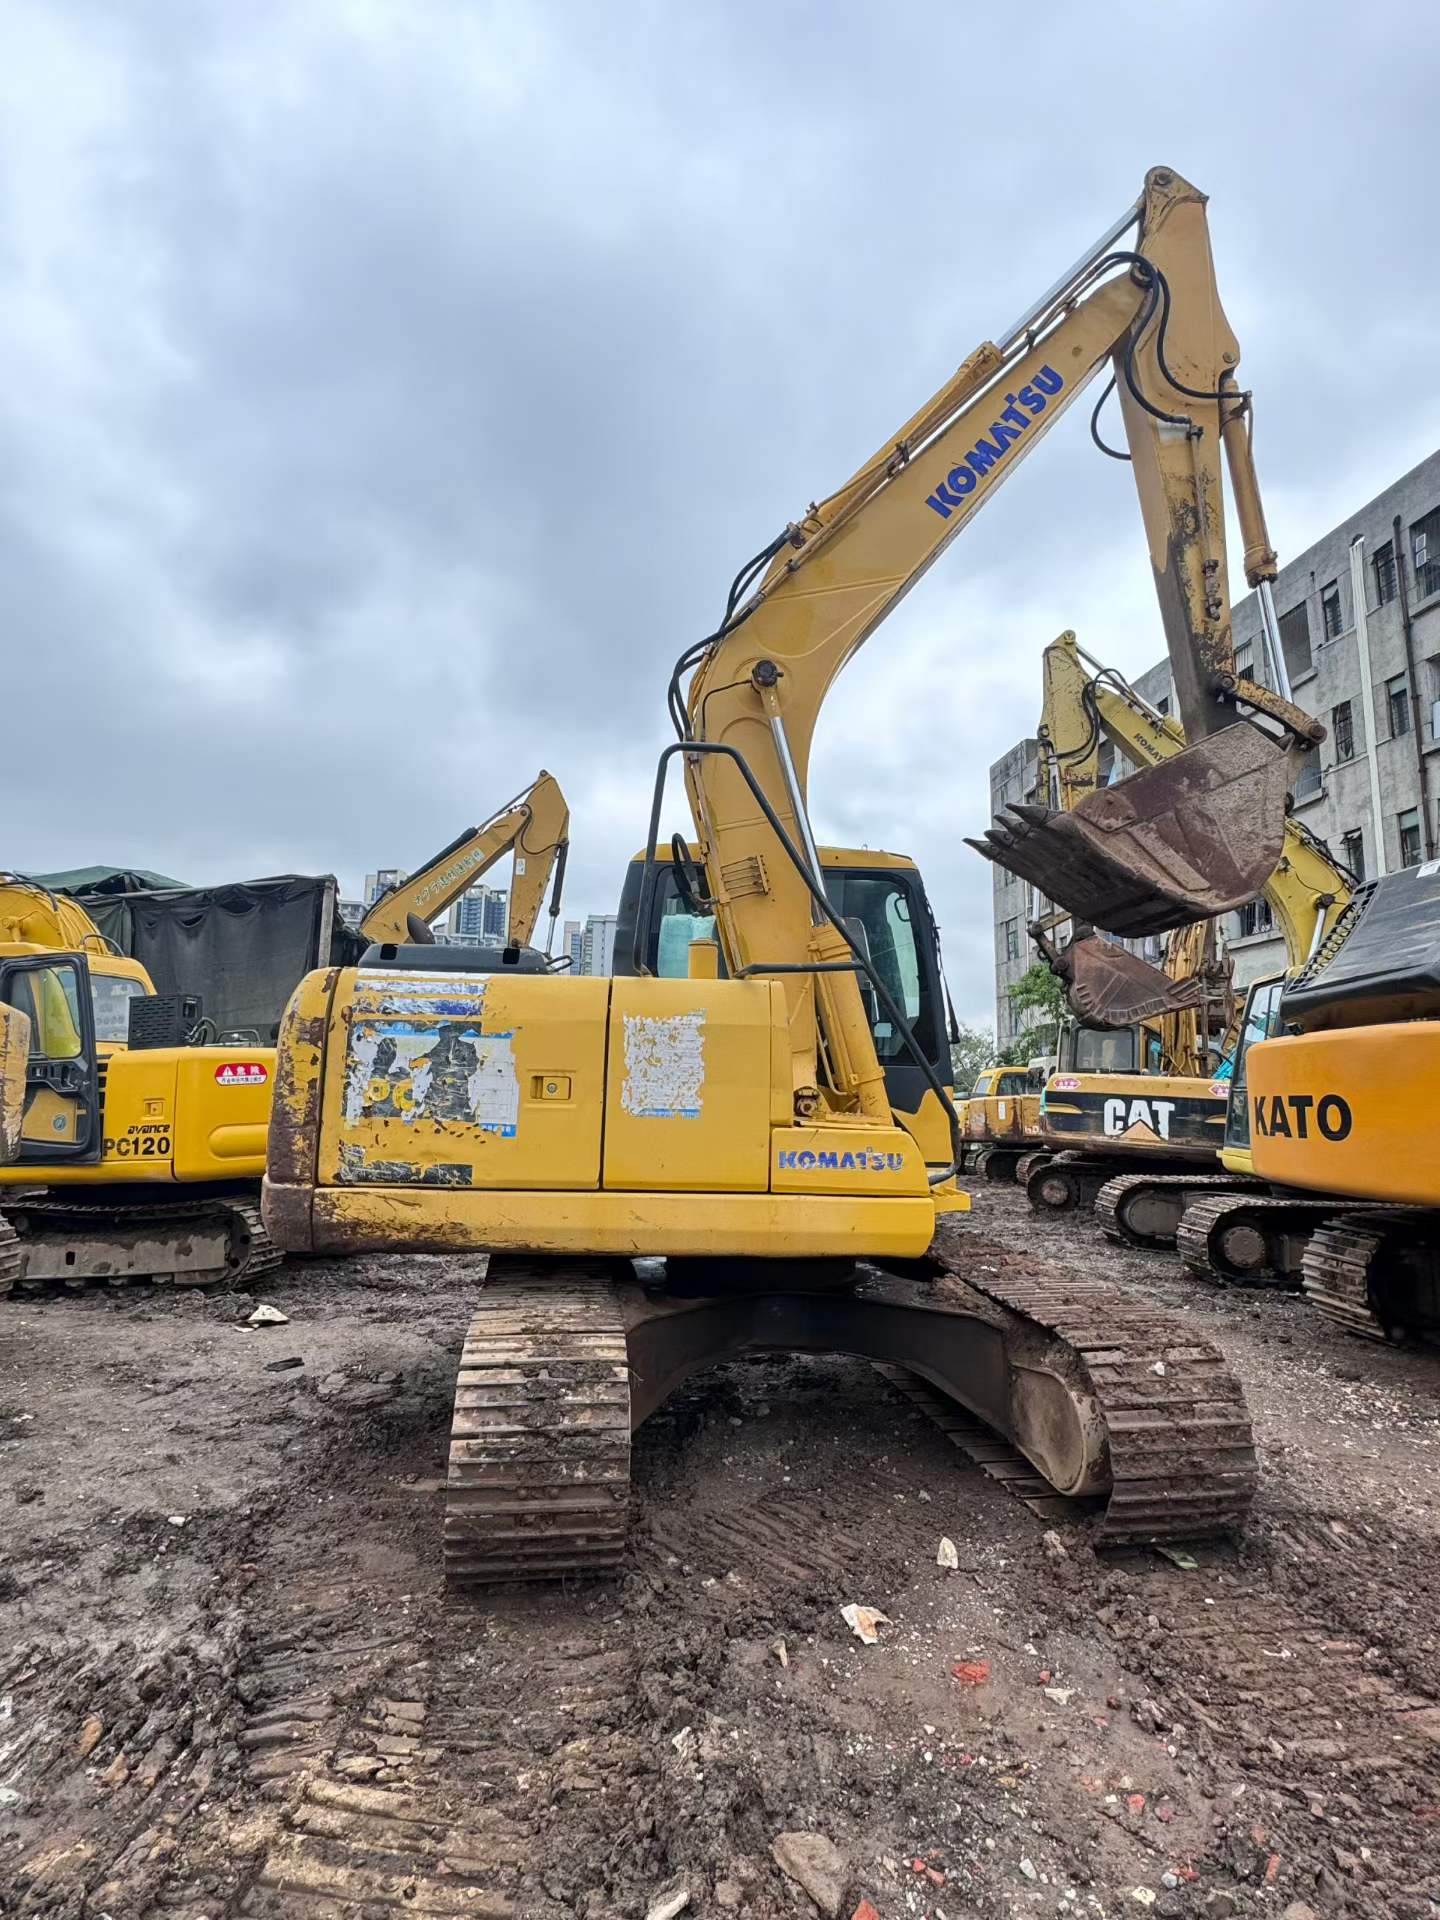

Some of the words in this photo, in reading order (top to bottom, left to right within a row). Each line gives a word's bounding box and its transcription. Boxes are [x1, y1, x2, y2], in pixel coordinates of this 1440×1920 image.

[925, 365, 1064, 519] KOMATSU
[1104, 1098, 1175, 1141] CAT
[1254, 1094, 1352, 1142] KATO
[103, 1136, 171, 1156] PC120
[778, 1147, 904, 1171] KOMATSU
